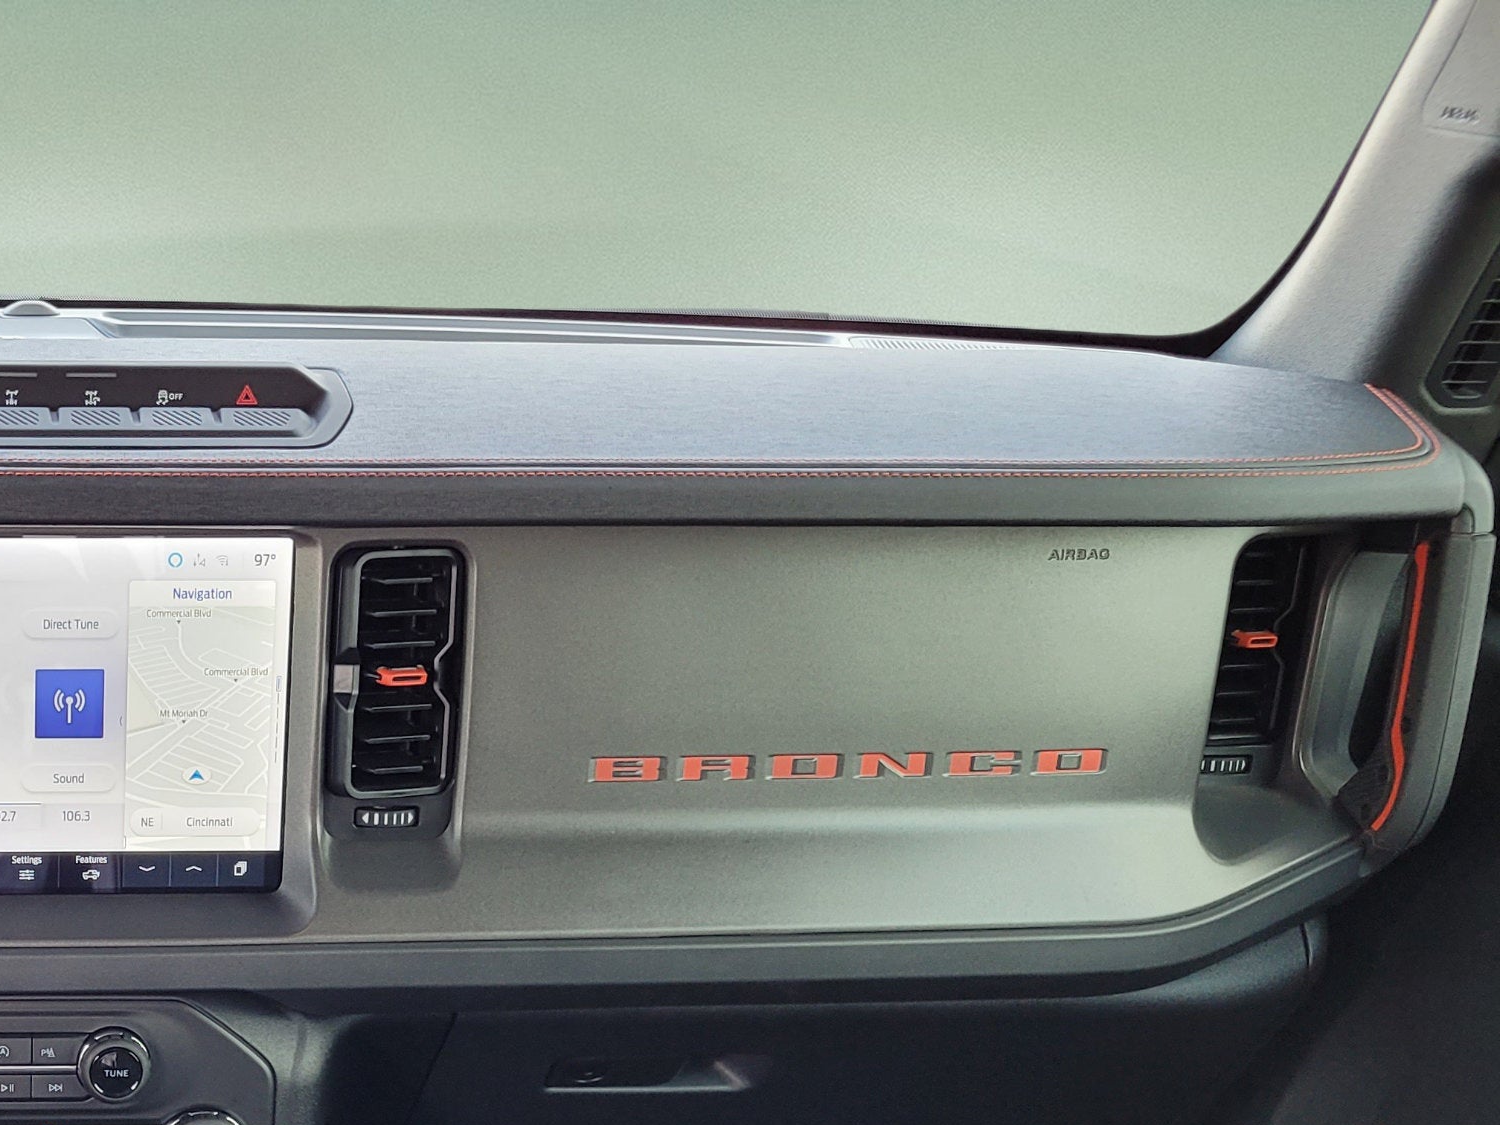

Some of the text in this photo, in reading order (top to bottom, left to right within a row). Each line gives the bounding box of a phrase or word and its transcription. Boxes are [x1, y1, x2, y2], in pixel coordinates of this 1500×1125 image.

[1048, 548, 1111, 561] AIRBAG
[172, 588, 233, 601] Navigation
[146, 609, 212, 618] Commercial Blvd
[43, 619, 99, 630] Direct Tune
[204, 668, 269, 677] Commercial Blvd
[160, 710, 209, 718] Mt Moriah Dr
[589, 748, 1109, 782] BRONCO
[53, 773, 85, 784] Sound
[62, 810, 91, 822] 106.3
[140, 817, 155, 827] NE
[186, 816, 233, 827] Cincinnati
[11, 855, 42, 865] Settings
[75, 855, 108, 864] Features
[104, 1069, 129, 1077] TUNE
